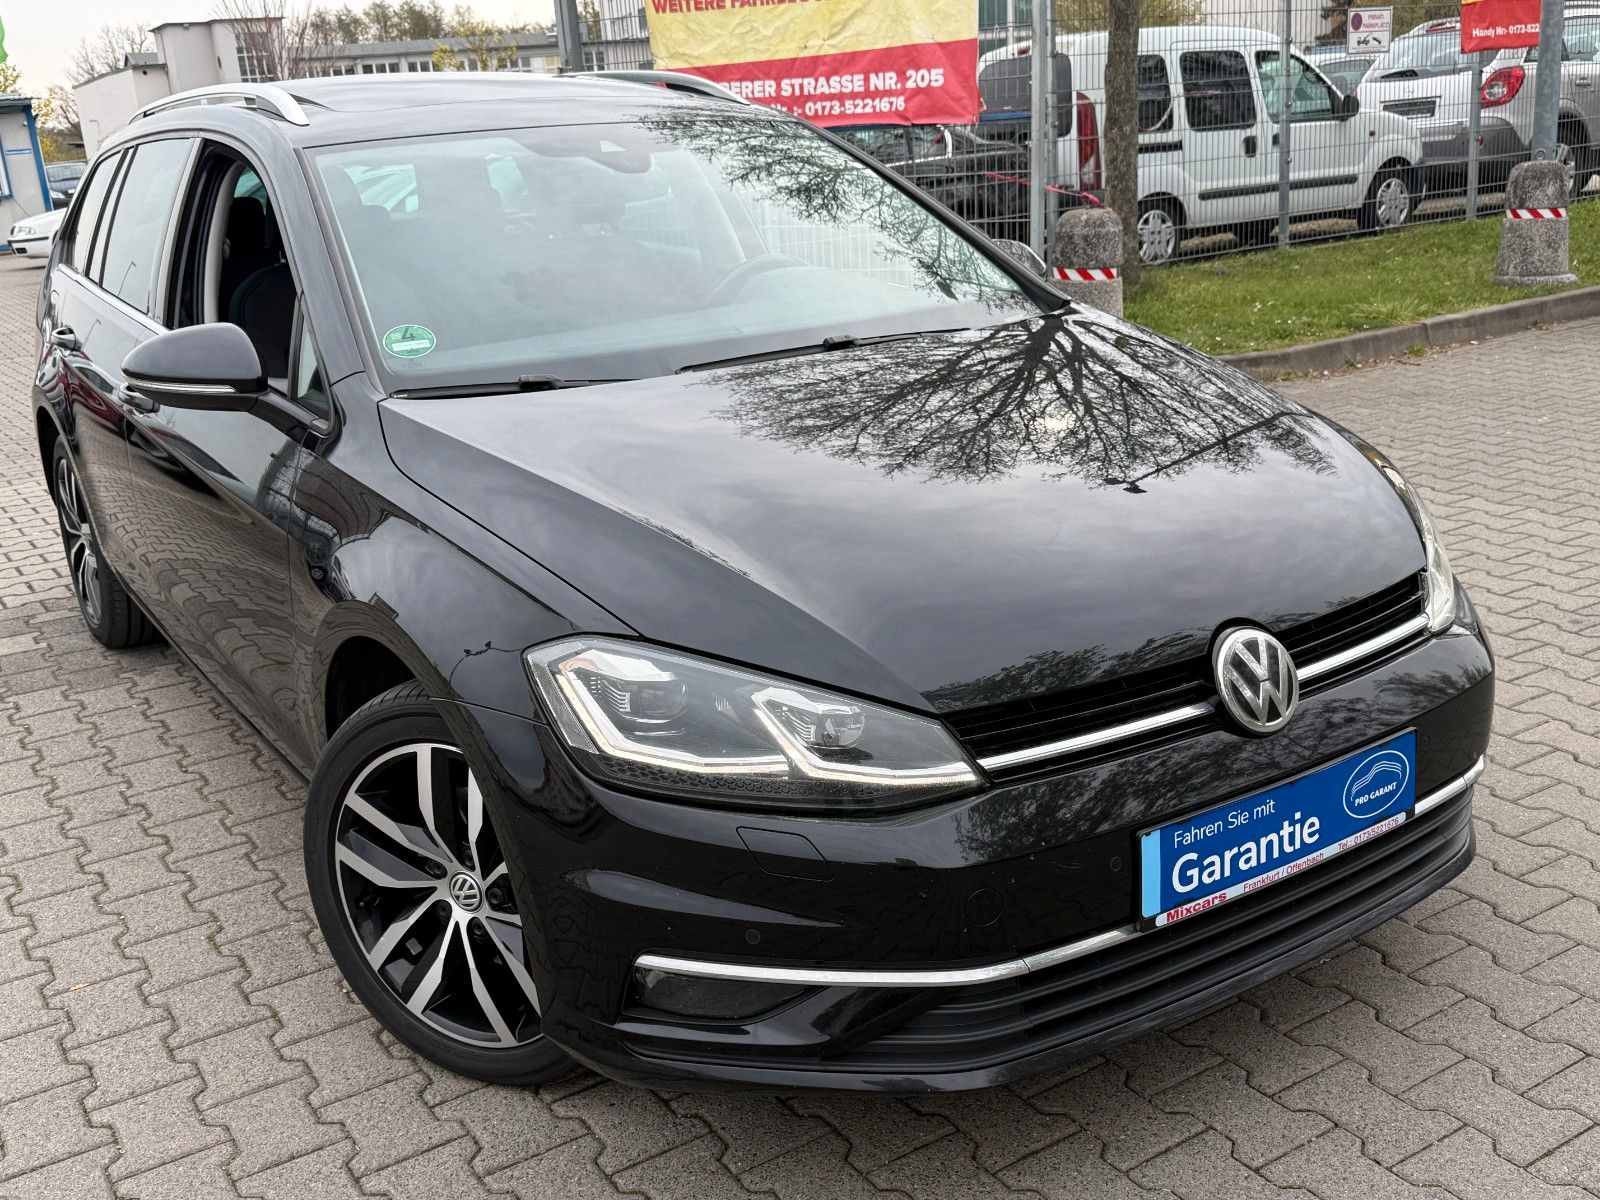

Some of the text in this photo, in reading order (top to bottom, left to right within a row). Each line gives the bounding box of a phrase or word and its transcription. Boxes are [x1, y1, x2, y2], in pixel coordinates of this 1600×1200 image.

[1472, 27, 1495, 38] Handy
[781, 75, 865, 96] STRASSE
[869, 72, 901, 91] NR.
[905, 69, 944, 89] 205
[805, 97, 905, 117] 0173-5221676
[1354, 781, 1398, 807] PRO GARANT
[1174, 799, 1276, 848] Fahren Sie mit
[1171, 813, 1320, 893] Garantie
[1243, 872, 1280, 892] Frankfurt
[1286, 853, 1324, 875] Offenbach
[1166, 892, 1227, 922] Mixcars
